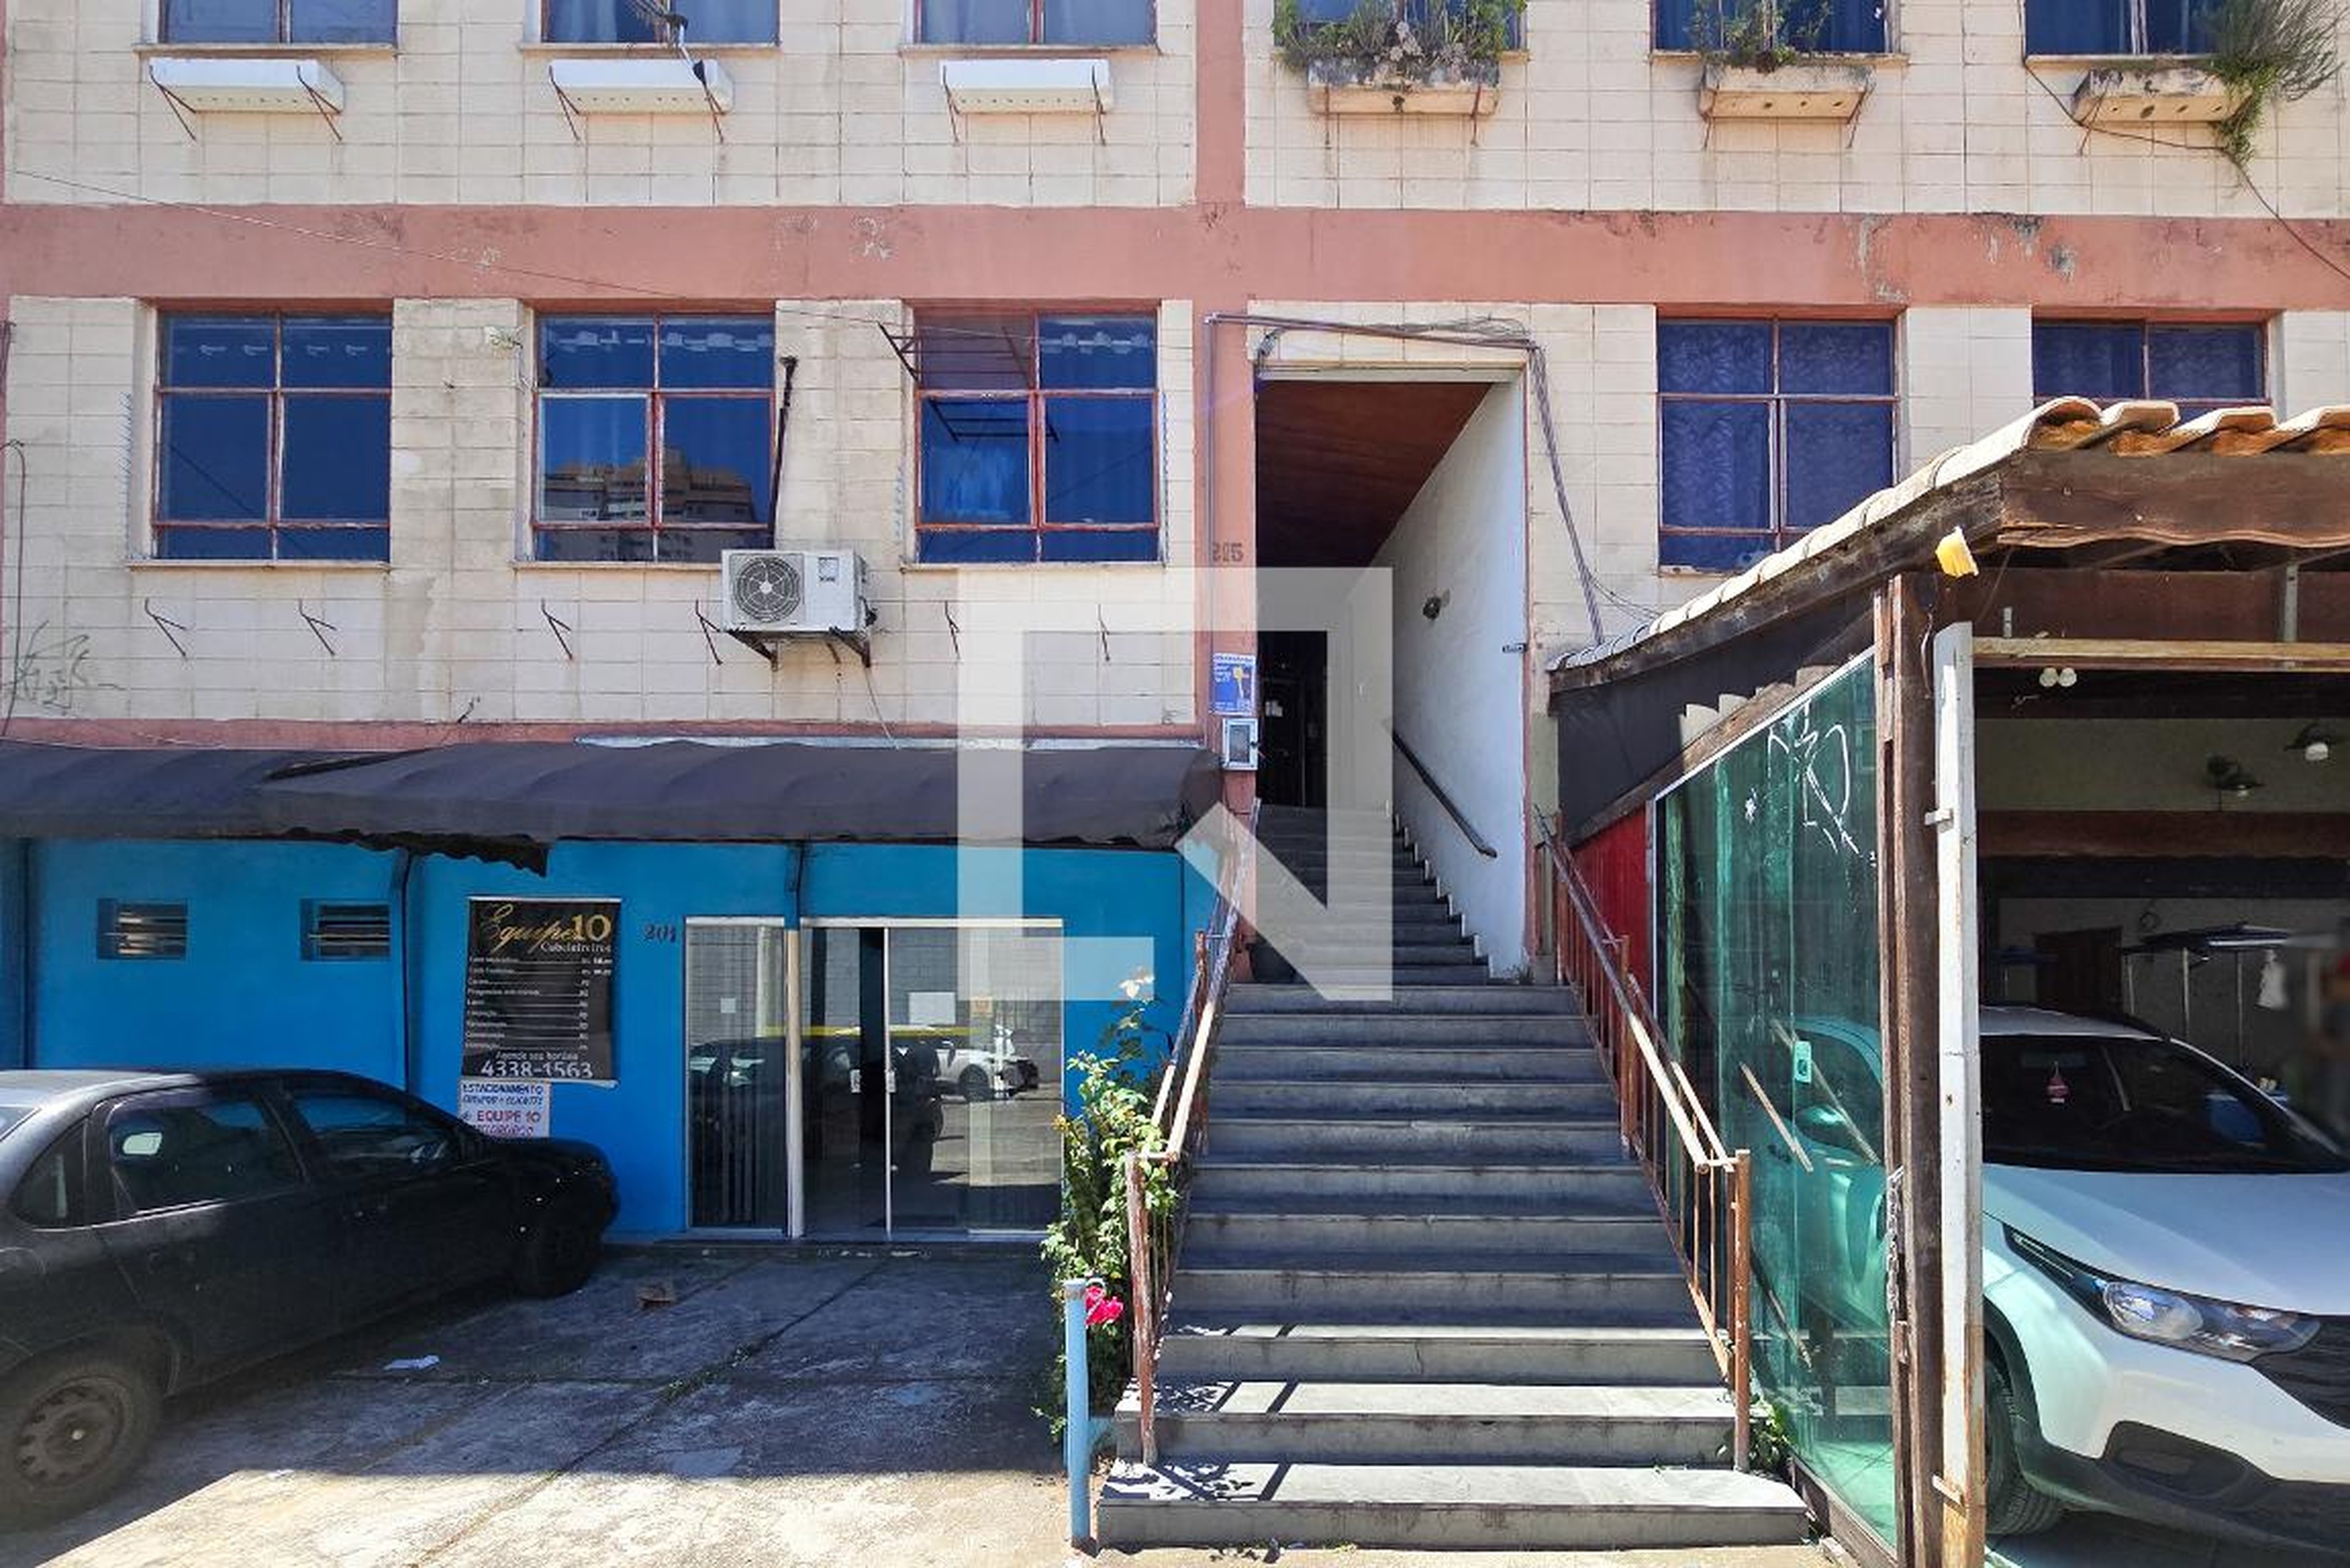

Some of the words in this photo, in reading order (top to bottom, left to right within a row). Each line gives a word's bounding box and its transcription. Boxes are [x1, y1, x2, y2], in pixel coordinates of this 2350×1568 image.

[572, 914, 611, 942] 10
[480, 1060, 594, 1078] 4338-1563
[477, 1110, 521, 1123] EQUIPE
